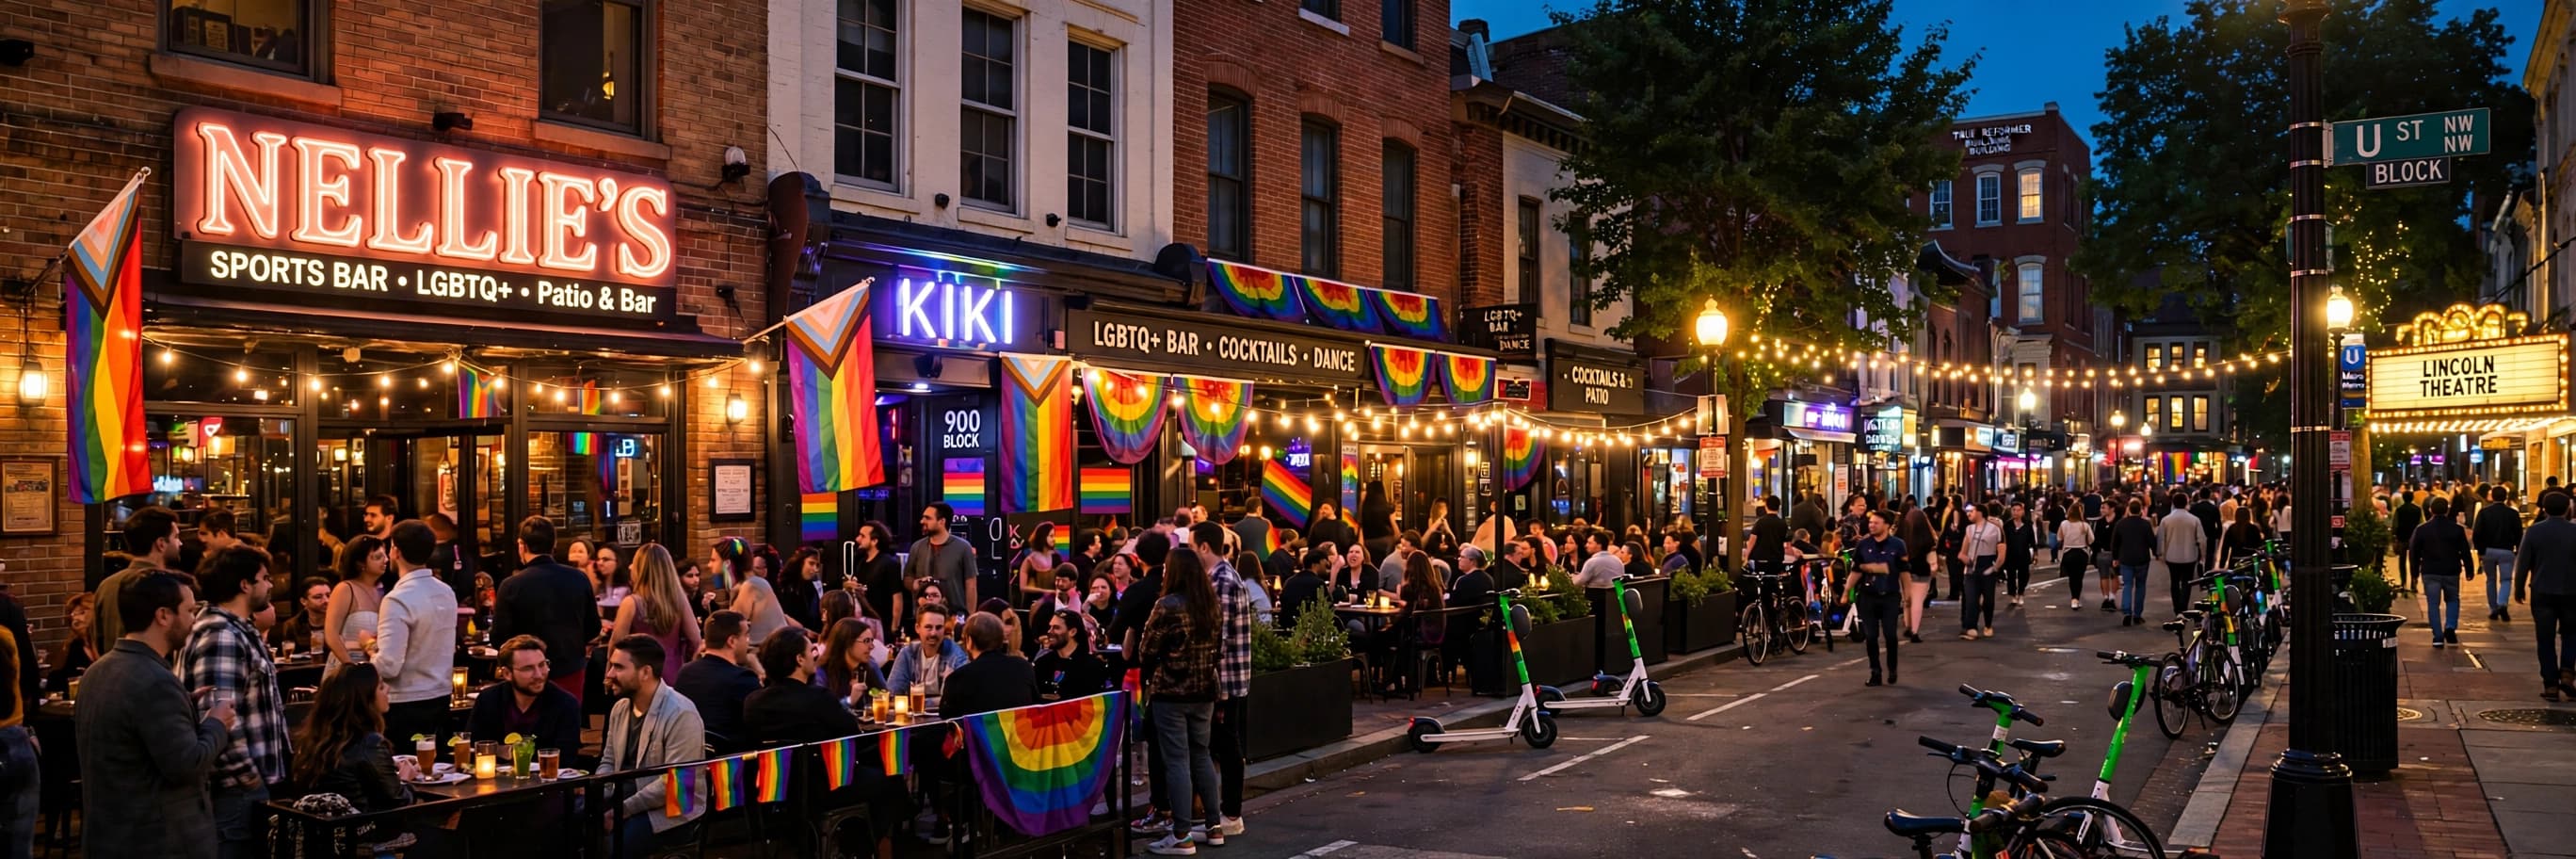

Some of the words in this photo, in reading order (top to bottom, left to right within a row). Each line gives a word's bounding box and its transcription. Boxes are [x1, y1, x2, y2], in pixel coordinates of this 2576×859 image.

[2357, 123, 2382, 158] U
[2396, 120, 2423, 140] ST
[2444, 114, 2473, 134] NW
[2444, 135, 2473, 153] NW
[2375, 158, 2443, 184] BLOCK
[197, 122, 672, 279] NELLIE'S
[210, 250, 325, 286] SPORTS
[333, 261, 389, 292] BAR
[417, 269, 513, 302] LGBTQ+
[538, 280, 593, 309] Patio
[598, 285, 615, 311] &
[620, 287, 657, 314] Bar
[900, 276, 1014, 345] KIKI
[1094, 320, 1161, 353] LGBTQ+
[1167, 329, 1199, 356] BAR
[1218, 335, 1297, 366] COCKTAILS
[1313, 347, 1356, 372] DANCE
[1571, 365, 1618, 387] COCKTAILS
[2423, 355, 2494, 378] LINCOLN
[1585, 387, 1609, 405] PATIO
[2420, 375, 2498, 397] THEATRE
[944, 409, 981, 432] 900
[943, 433, 980, 449] BLOCK
